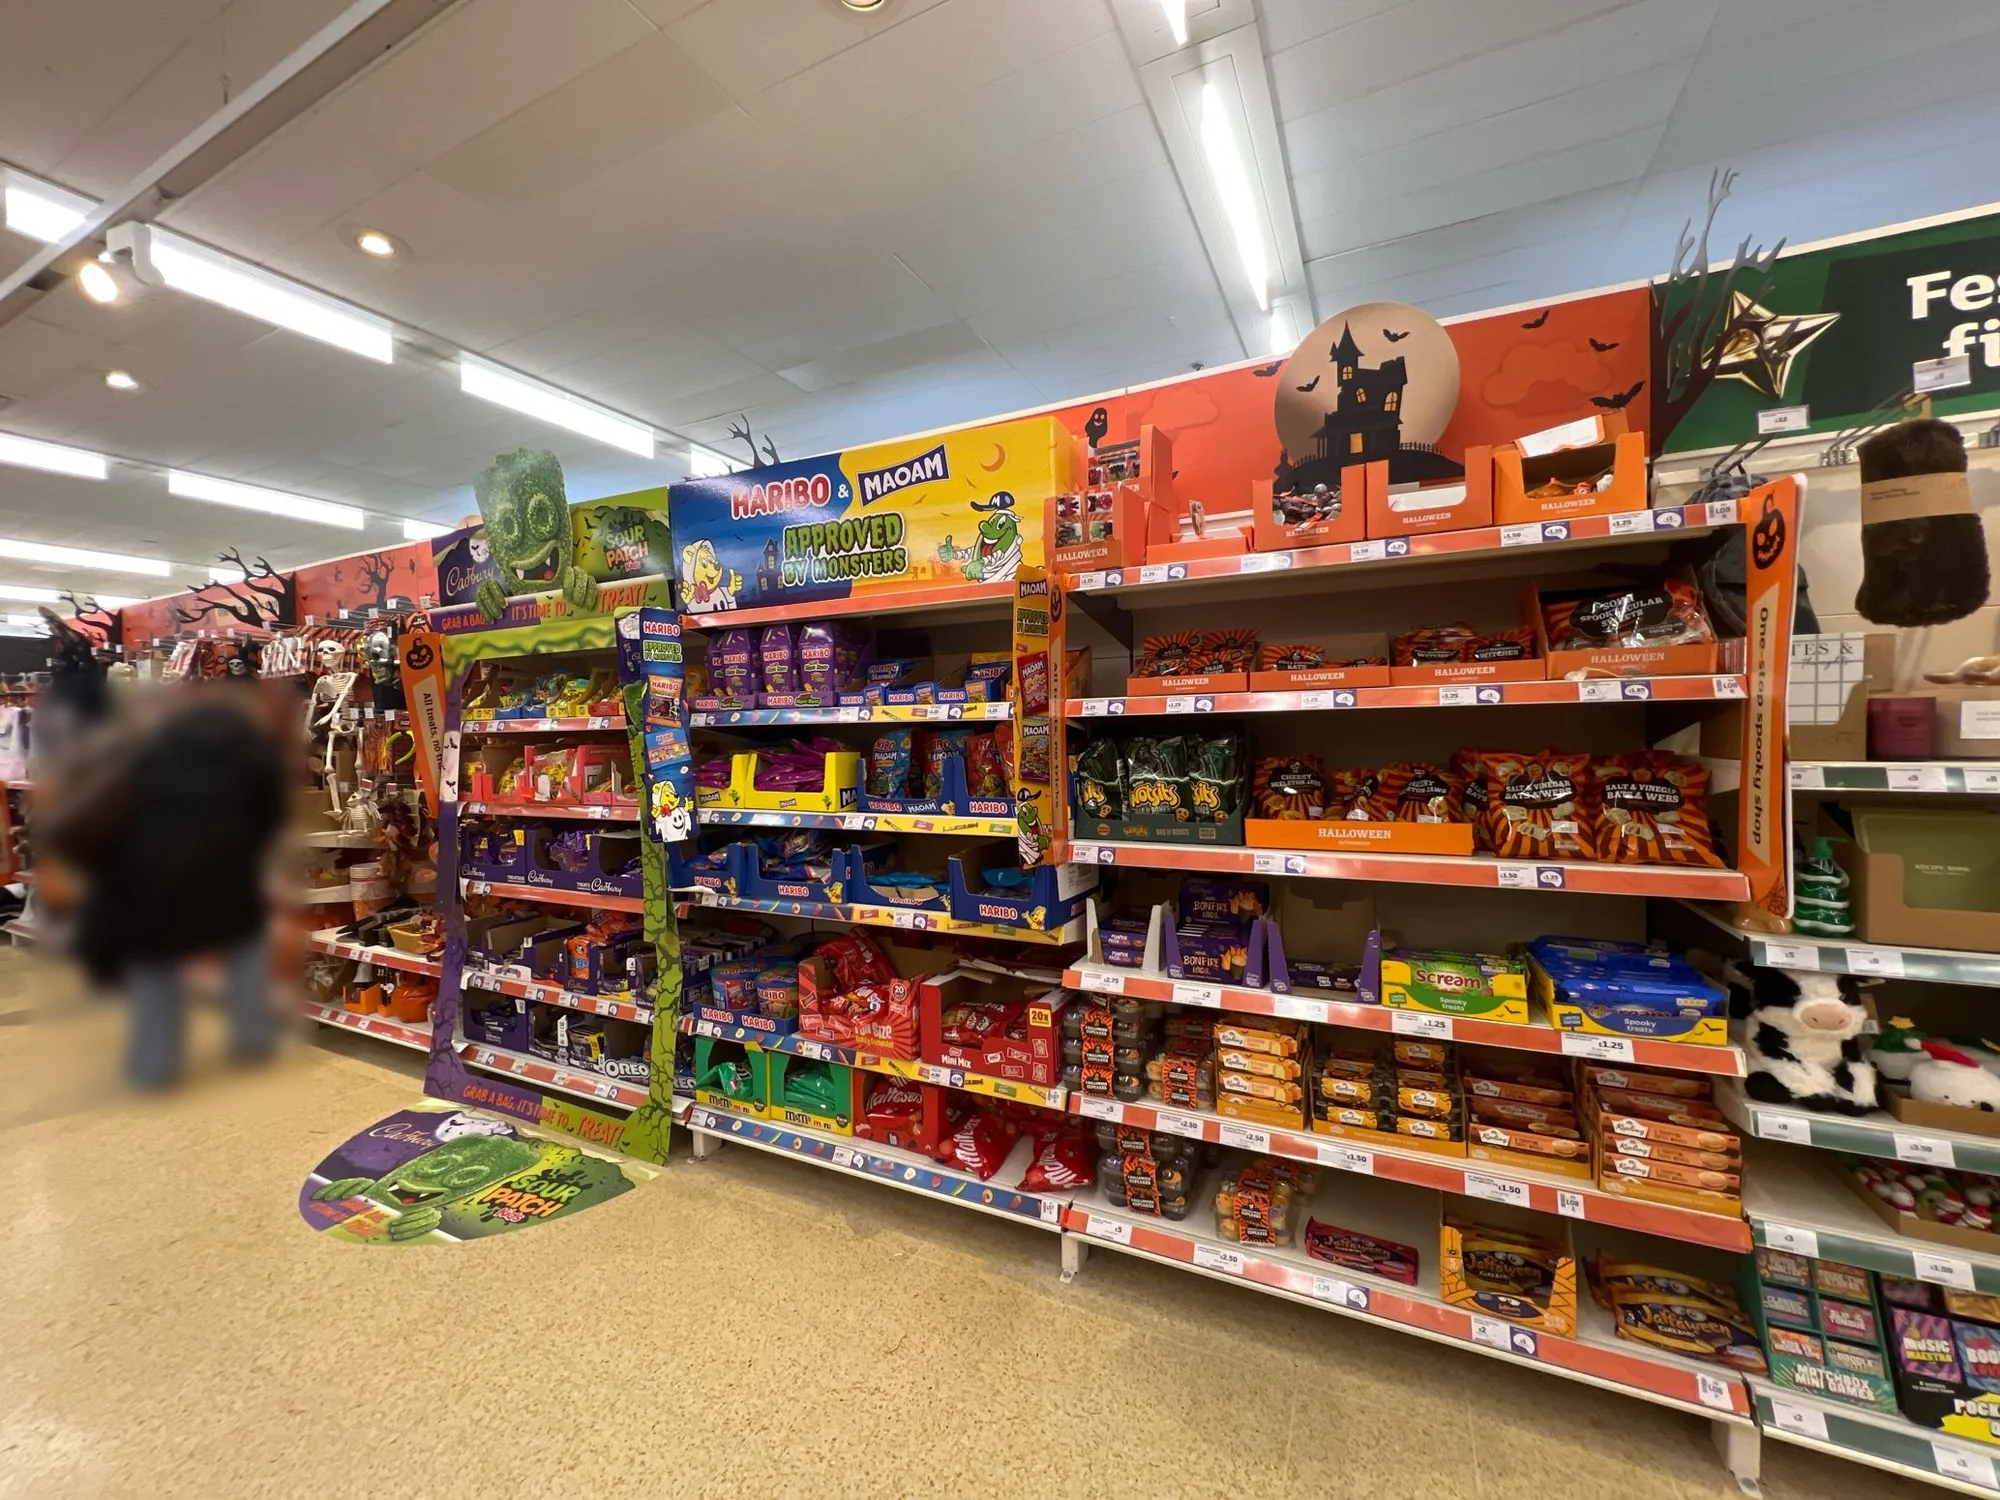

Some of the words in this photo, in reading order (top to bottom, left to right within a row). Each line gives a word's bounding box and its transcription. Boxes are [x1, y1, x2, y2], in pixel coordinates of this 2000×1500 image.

[1906, 268, 2000, 320] Fe
[731, 476, 832, 520] HARIBO
[837, 484, 849, 499] &
[863, 452, 944, 499] MAOAM
[1541, 498, 1596, 511] HALLOWEEN
[1402, 512, 1452, 524] HALLOWEEN
[605, 525, 645, 549] SOUR
[784, 513, 904, 556] APPROVED
[1285, 526, 1329, 538] HALLOWEEN
[606, 540, 649, 567] PATCH
[1056, 547, 1108, 562] HALLOWEEN
[783, 559, 807, 586] BY
[813, 546, 907, 585] MONSTERS
[446, 567, 495, 597] Cadbury
[1020, 580, 1047, 598] MAOAM
[441, 615, 461, 630] GRAB
[463, 614, 469, 627] A
[511, 602, 529, 621] IT'S
[528, 601, 552, 619] TIME
[552, 600, 567, 617] TO
[599, 582, 649, 613] TREAT!
[1580, 597, 1664, 622] SPOOKTCULAR
[643, 621, 682, 637] HARIBO
[644, 641, 682, 655] APPROVED
[801, 648, 830, 659] HARIBO
[1840, 642, 1854, 655] &
[723, 653, 747, 664] HARIBO
[763, 650, 789, 662] HARIBO
[1591, 652, 1665, 664] HALLOWEEN
[1756, 606, 1769, 707] One-stop
[971, 667, 1005, 679] HARIBO
[1022, 660, 1045, 677] MAOAM
[1434, 666, 1496, 677] HALLOWEEN
[1162, 677, 1210, 687] HALLOWEEN
[1290, 672, 1345, 682] HALLOWEEN
[650, 679, 680, 692] HARIBO
[421, 691, 433, 712] All
[767, 695, 793, 706] HARIBO
[840, 695, 863, 705] HARIBO
[888, 693, 914, 702] HARIBO
[938, 692, 966, 701] HARIBO
[695, 699, 719, 710] HARIBO
[426, 712, 438, 741] treats,
[1023, 725, 1049, 736] MAOAM
[432, 739, 442, 753] no
[1752, 711, 1765, 793] spooky
[874, 750, 898, 761] MAOAM
[1505, 783, 1526, 794] SALT
[1533, 779, 1571, 791] VINEGAR
[1540, 786, 1572, 800] WEBS
[1605, 783, 1628, 793] SALT
[1639, 784, 1678, 795] VINEGAR
[700, 792, 720, 803] MAOAM
[1606, 790, 1630, 801] BATS
[1642, 791, 1680, 803] WEBS
[780, 799, 797, 808] MAOAM
[868, 800, 902, 812] HARIBO
[907, 802, 937, 814] MAOAM
[969, 801, 1007, 814] HARIBO
[1753, 798, 1763, 846] shop
[1318, 827, 1391, 839] HALLOWEEN
[461, 863, 486, 879] Cadbury
[527, 869, 553, 886] Cadbury
[590, 877, 623, 896] Cadbury
[694, 875, 722, 888] HARIBO
[778, 885, 810, 897] HARIBO
[979, 903, 1018, 921] HARIBO
[1193, 900, 1228, 912] BONFIRE
[1183, 954, 1220, 968] BONFIRE
[1416, 969, 1481, 989] Scream
[894, 985, 904, 994] 20
[1439, 996, 1468, 1006] Spooky
[1441, 1004, 1465, 1012] treats
[701, 1007, 734, 1023] HARIBO
[741, 1014, 775, 1032] HARIBO
[1031, 1010, 1049, 1021] 20x
[1424, 1020, 1446, 1028] £1.25
[1624, 1018, 1657, 1028] Spooky
[1626, 1025, 1654, 1034] treats
[871, 1021, 892, 1039] Size
[1599, 1040, 1624, 1049] £1.25
[941, 1054, 957, 1066] Mini
[957, 1056, 972, 1069] Mix
[1225, 1057, 1247, 1070] Kipling
[605, 1060, 650, 1077] OREO
[1225, 1079, 1248, 1092] Kipling
[1412, 1095, 1436, 1106] Kipling
[463, 1084, 487, 1103] GRAB
[488, 1091, 495, 1105] A
[498, 1093, 517, 1112] BAG,
[517, 1098, 534, 1116] IT'S
[532, 1101, 557, 1125] TIME
[556, 1110, 570, 1129] TO
[575, 1115, 626, 1149] TREAT!
[1180, 1120, 1198, 1129] £2.50
[1411, 1125, 1434, 1136] Kipling
[1616, 1123, 1645, 1137] Kipling
[368, 1123, 441, 1149] Cadbury
[1246, 1133, 1265, 1142] £2.50
[1482, 1132, 1508, 1145] Kipling
[1619, 1142, 1648, 1156] Kipling
[1347, 1154, 1367, 1163] £1.50
[1618, 1163, 1647, 1177] Kipling
[512, 1174, 582, 1202] SOUR
[1498, 1184, 1521, 1195] £1.50
[485, 1187, 564, 1218] PATCH
[1220, 1253, 1238, 1263] £2.50
[1642, 1305, 1732, 1339] Jaffaween
[1903, 1337, 1950, 1353] MUSIC
[1797, 1363, 1870, 1389] MATCHBOX
[1795, 1373, 1824, 1391] MINI
[1828, 1379, 1875, 1401] GAMES
